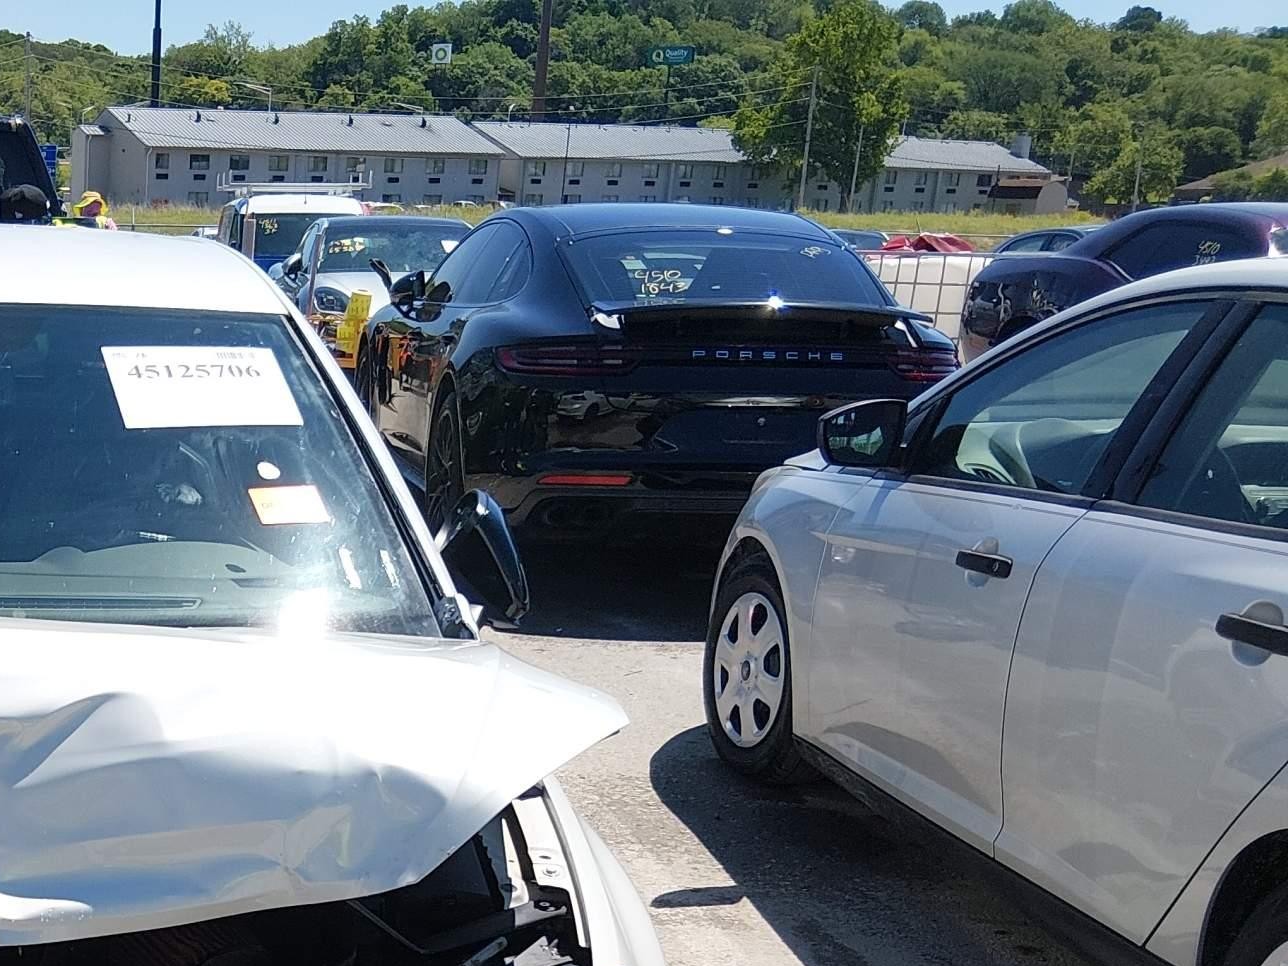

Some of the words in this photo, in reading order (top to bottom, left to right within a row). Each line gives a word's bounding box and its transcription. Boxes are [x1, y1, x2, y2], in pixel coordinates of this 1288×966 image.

[665, 49, 689, 57] Quality
[635, 270, 681, 282] 4510
[692, 350, 843, 361] PORSCHE
[127, 364, 261, 379] 45125706
